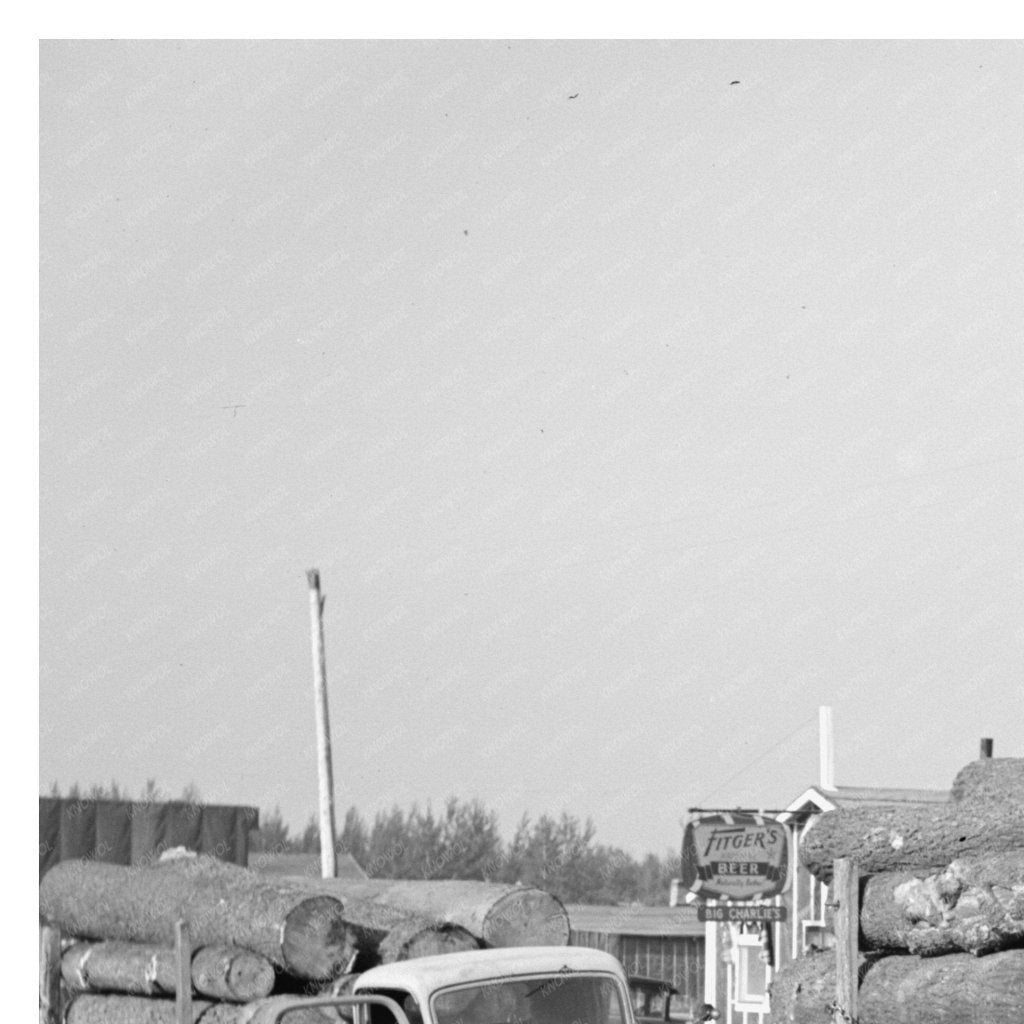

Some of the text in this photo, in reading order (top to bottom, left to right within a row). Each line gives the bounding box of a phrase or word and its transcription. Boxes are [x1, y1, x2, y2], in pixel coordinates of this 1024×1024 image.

[704, 827, 778, 857] FITGER'S
[718, 863, 759, 875] BEER
[705, 907, 781, 920] BIG CHARLIE'S
